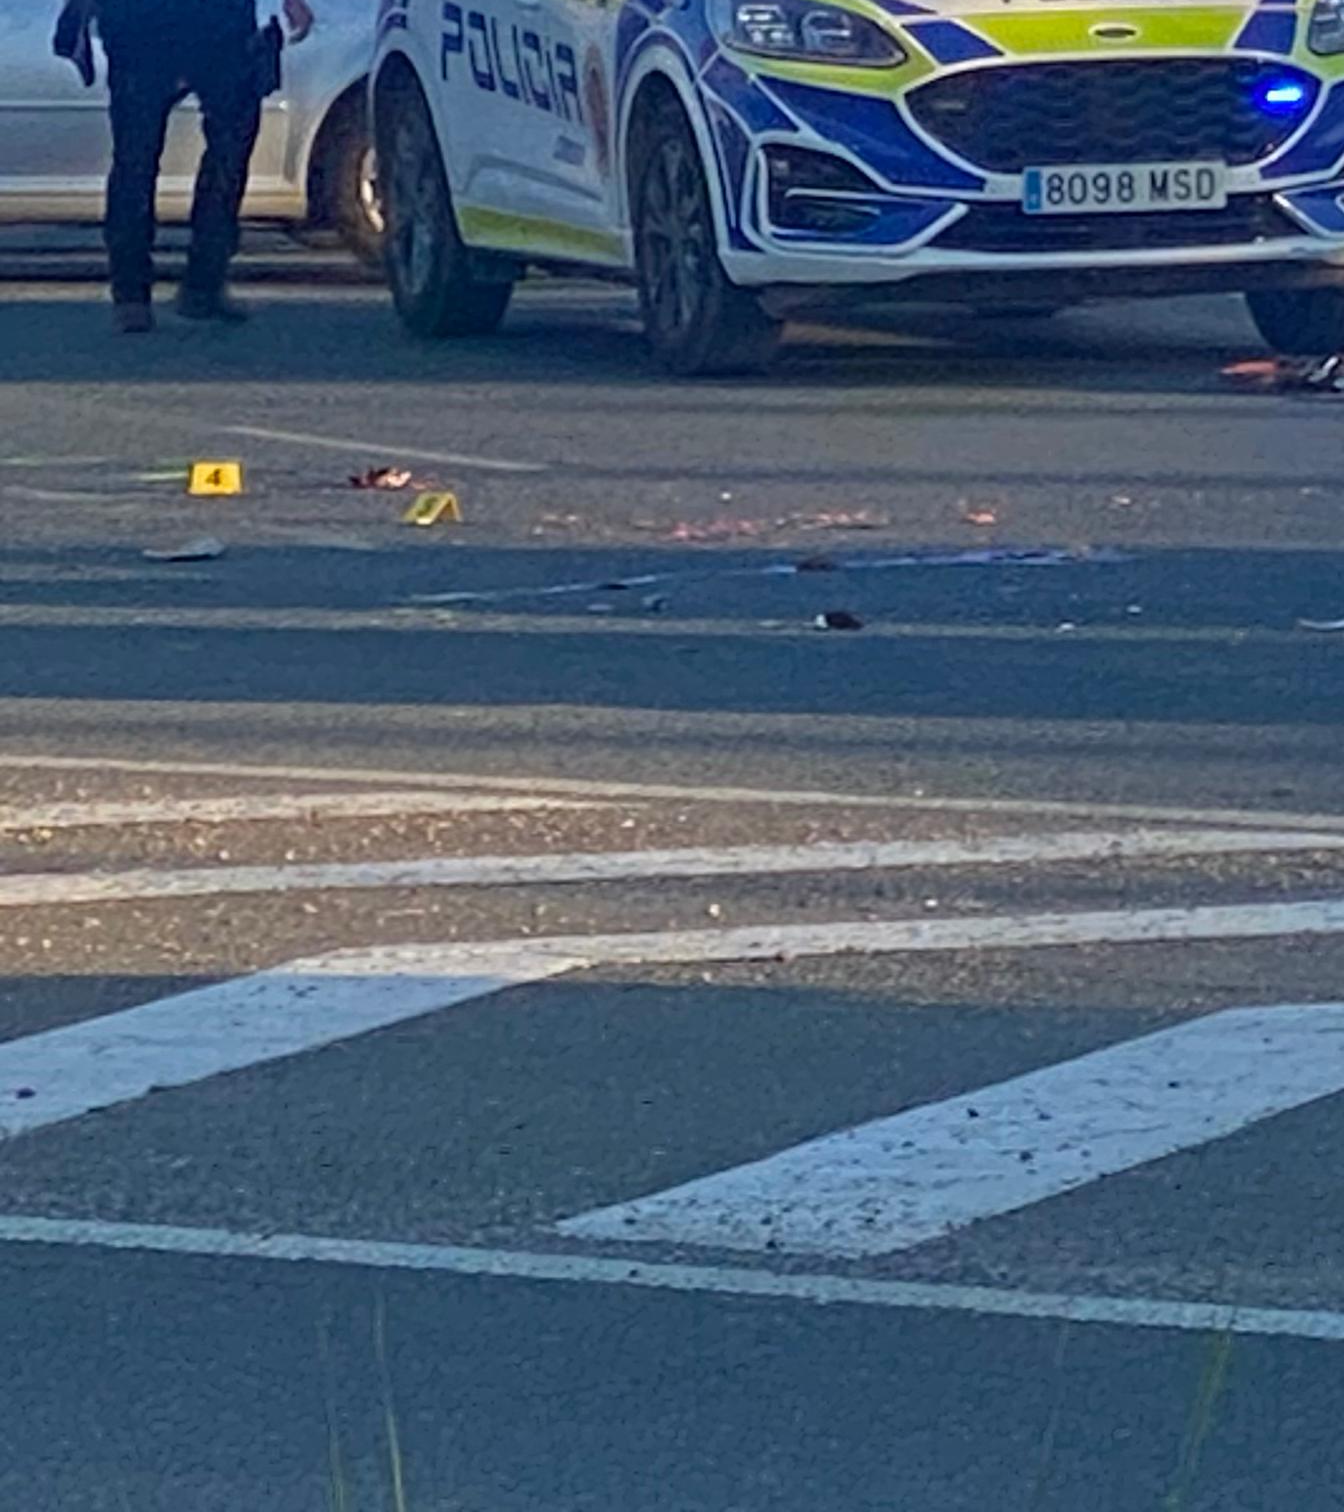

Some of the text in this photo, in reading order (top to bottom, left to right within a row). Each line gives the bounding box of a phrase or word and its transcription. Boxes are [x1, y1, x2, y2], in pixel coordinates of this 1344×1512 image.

[441, 1, 583, 122] POLICIA
[1047, 168, 1216, 205] 8098 MSD
